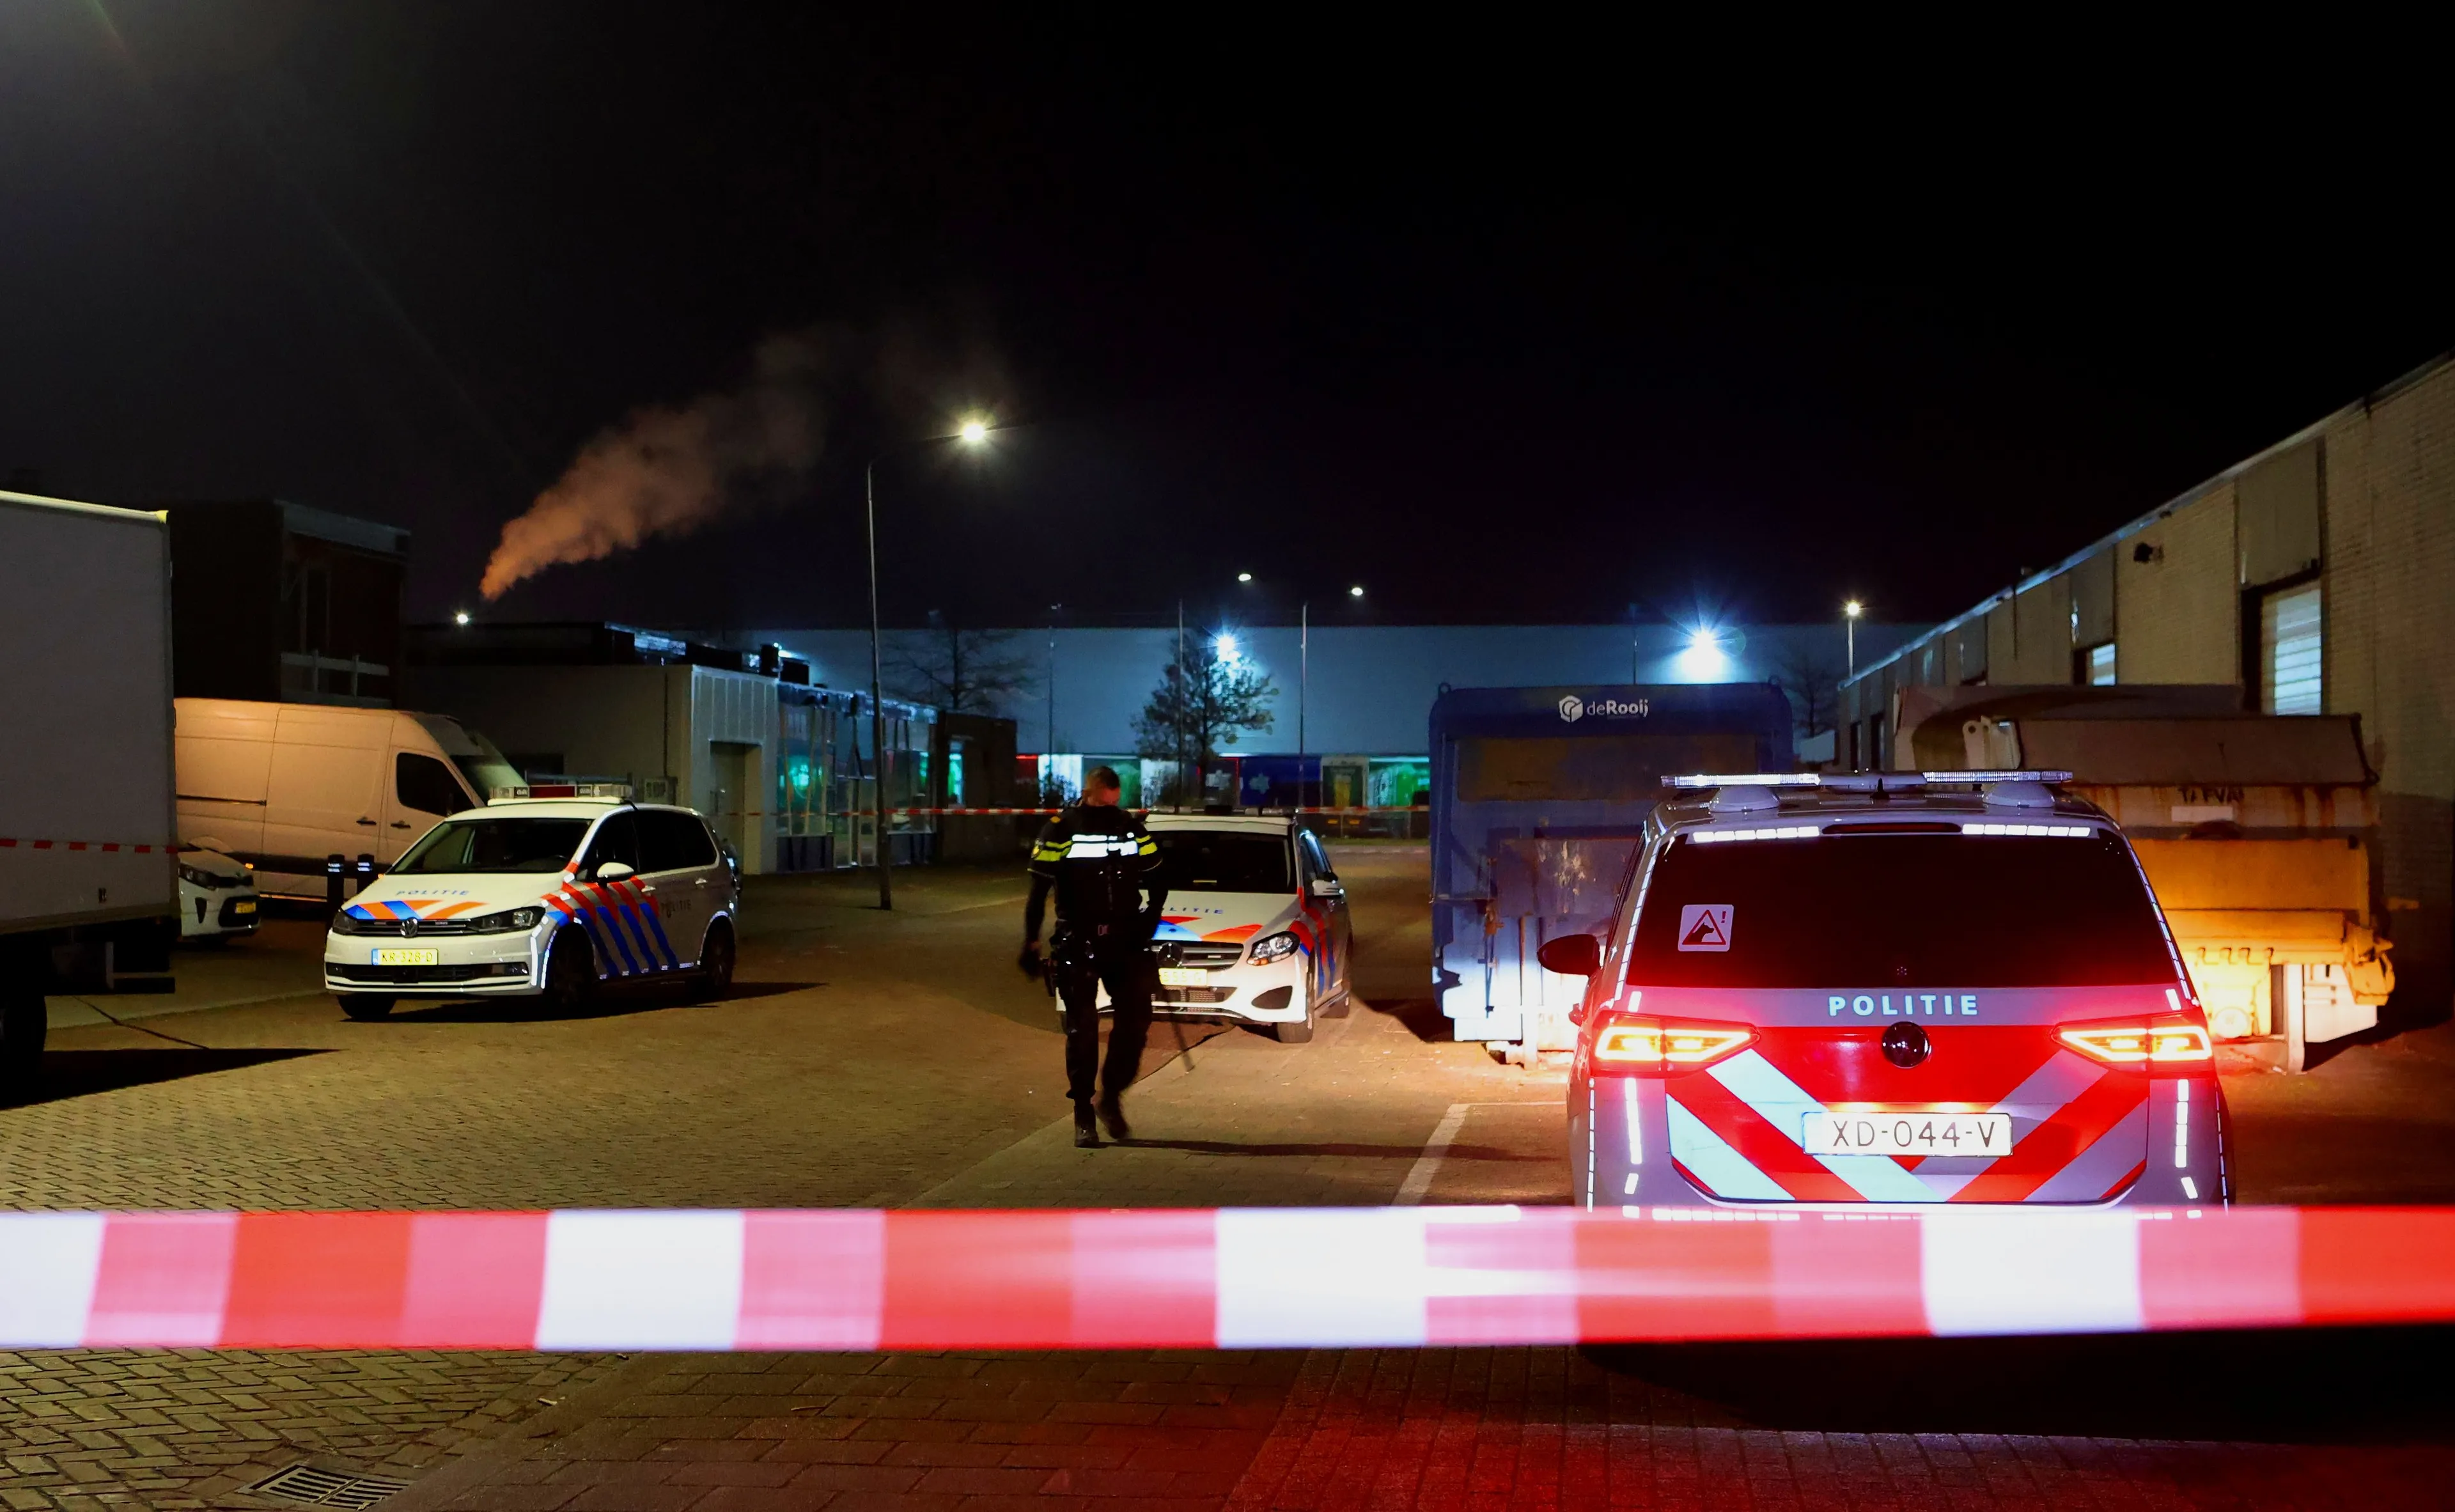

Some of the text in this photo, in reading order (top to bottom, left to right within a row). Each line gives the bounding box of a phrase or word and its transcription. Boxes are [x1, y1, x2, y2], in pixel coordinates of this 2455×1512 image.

[1586, 698, 1649, 717] deRooij
[382, 951, 433, 962] KR-328-D
[1828, 994, 1979, 1017] POLITIE
[1833, 1120, 1995, 1148] XD-044-V
